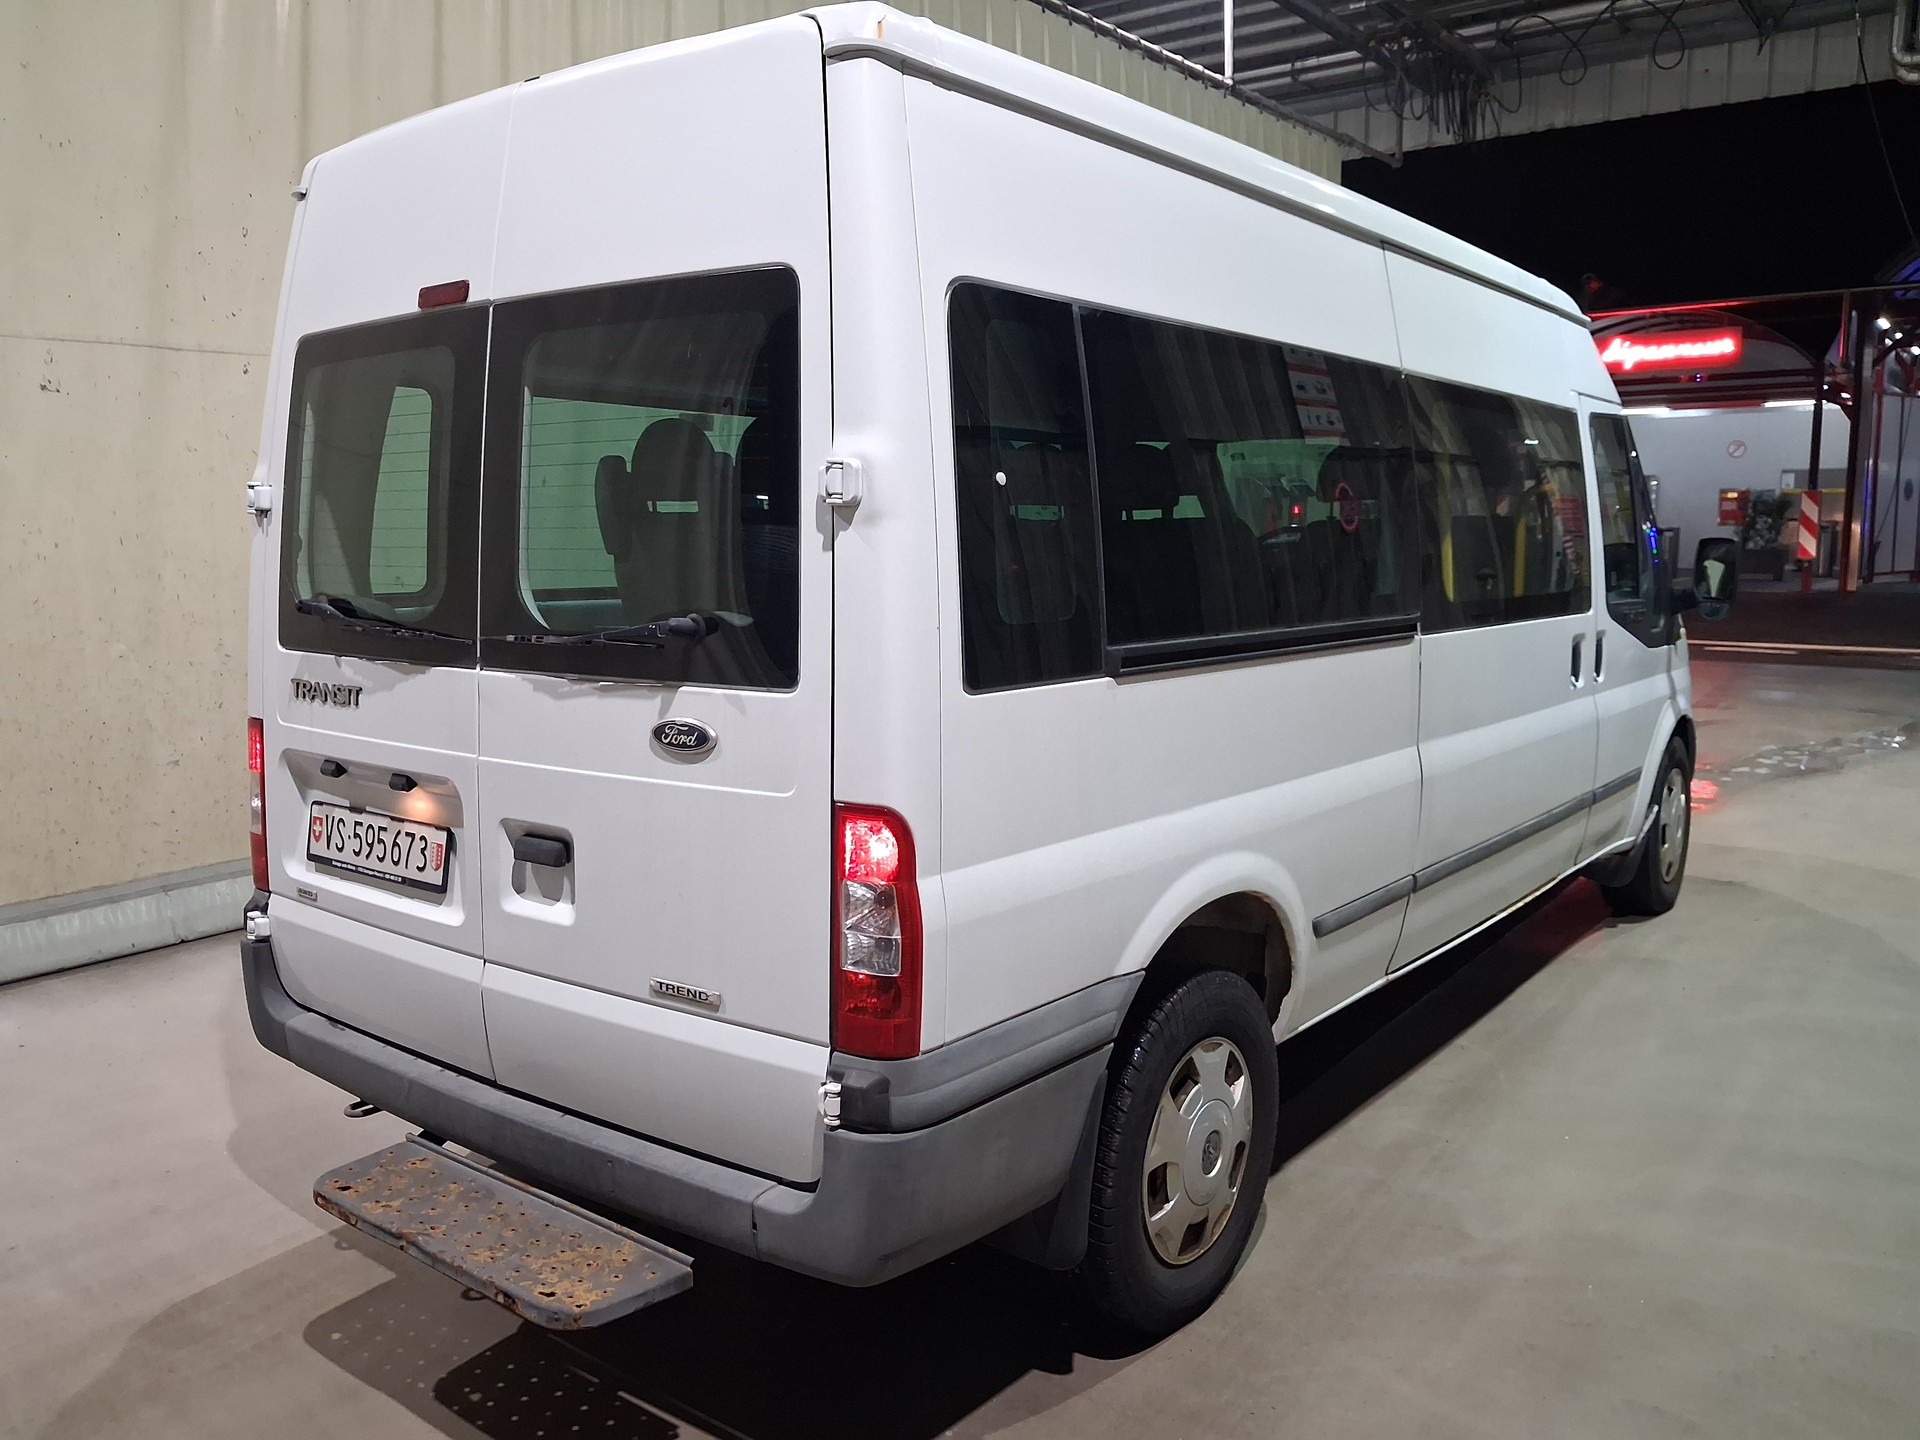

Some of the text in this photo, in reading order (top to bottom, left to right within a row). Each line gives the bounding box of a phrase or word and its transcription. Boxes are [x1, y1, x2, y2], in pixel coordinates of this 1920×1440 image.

[290, 678, 363, 709] TRANSIT
[661, 724, 698, 746] Ford
[656, 980, 711, 1001] TREND
